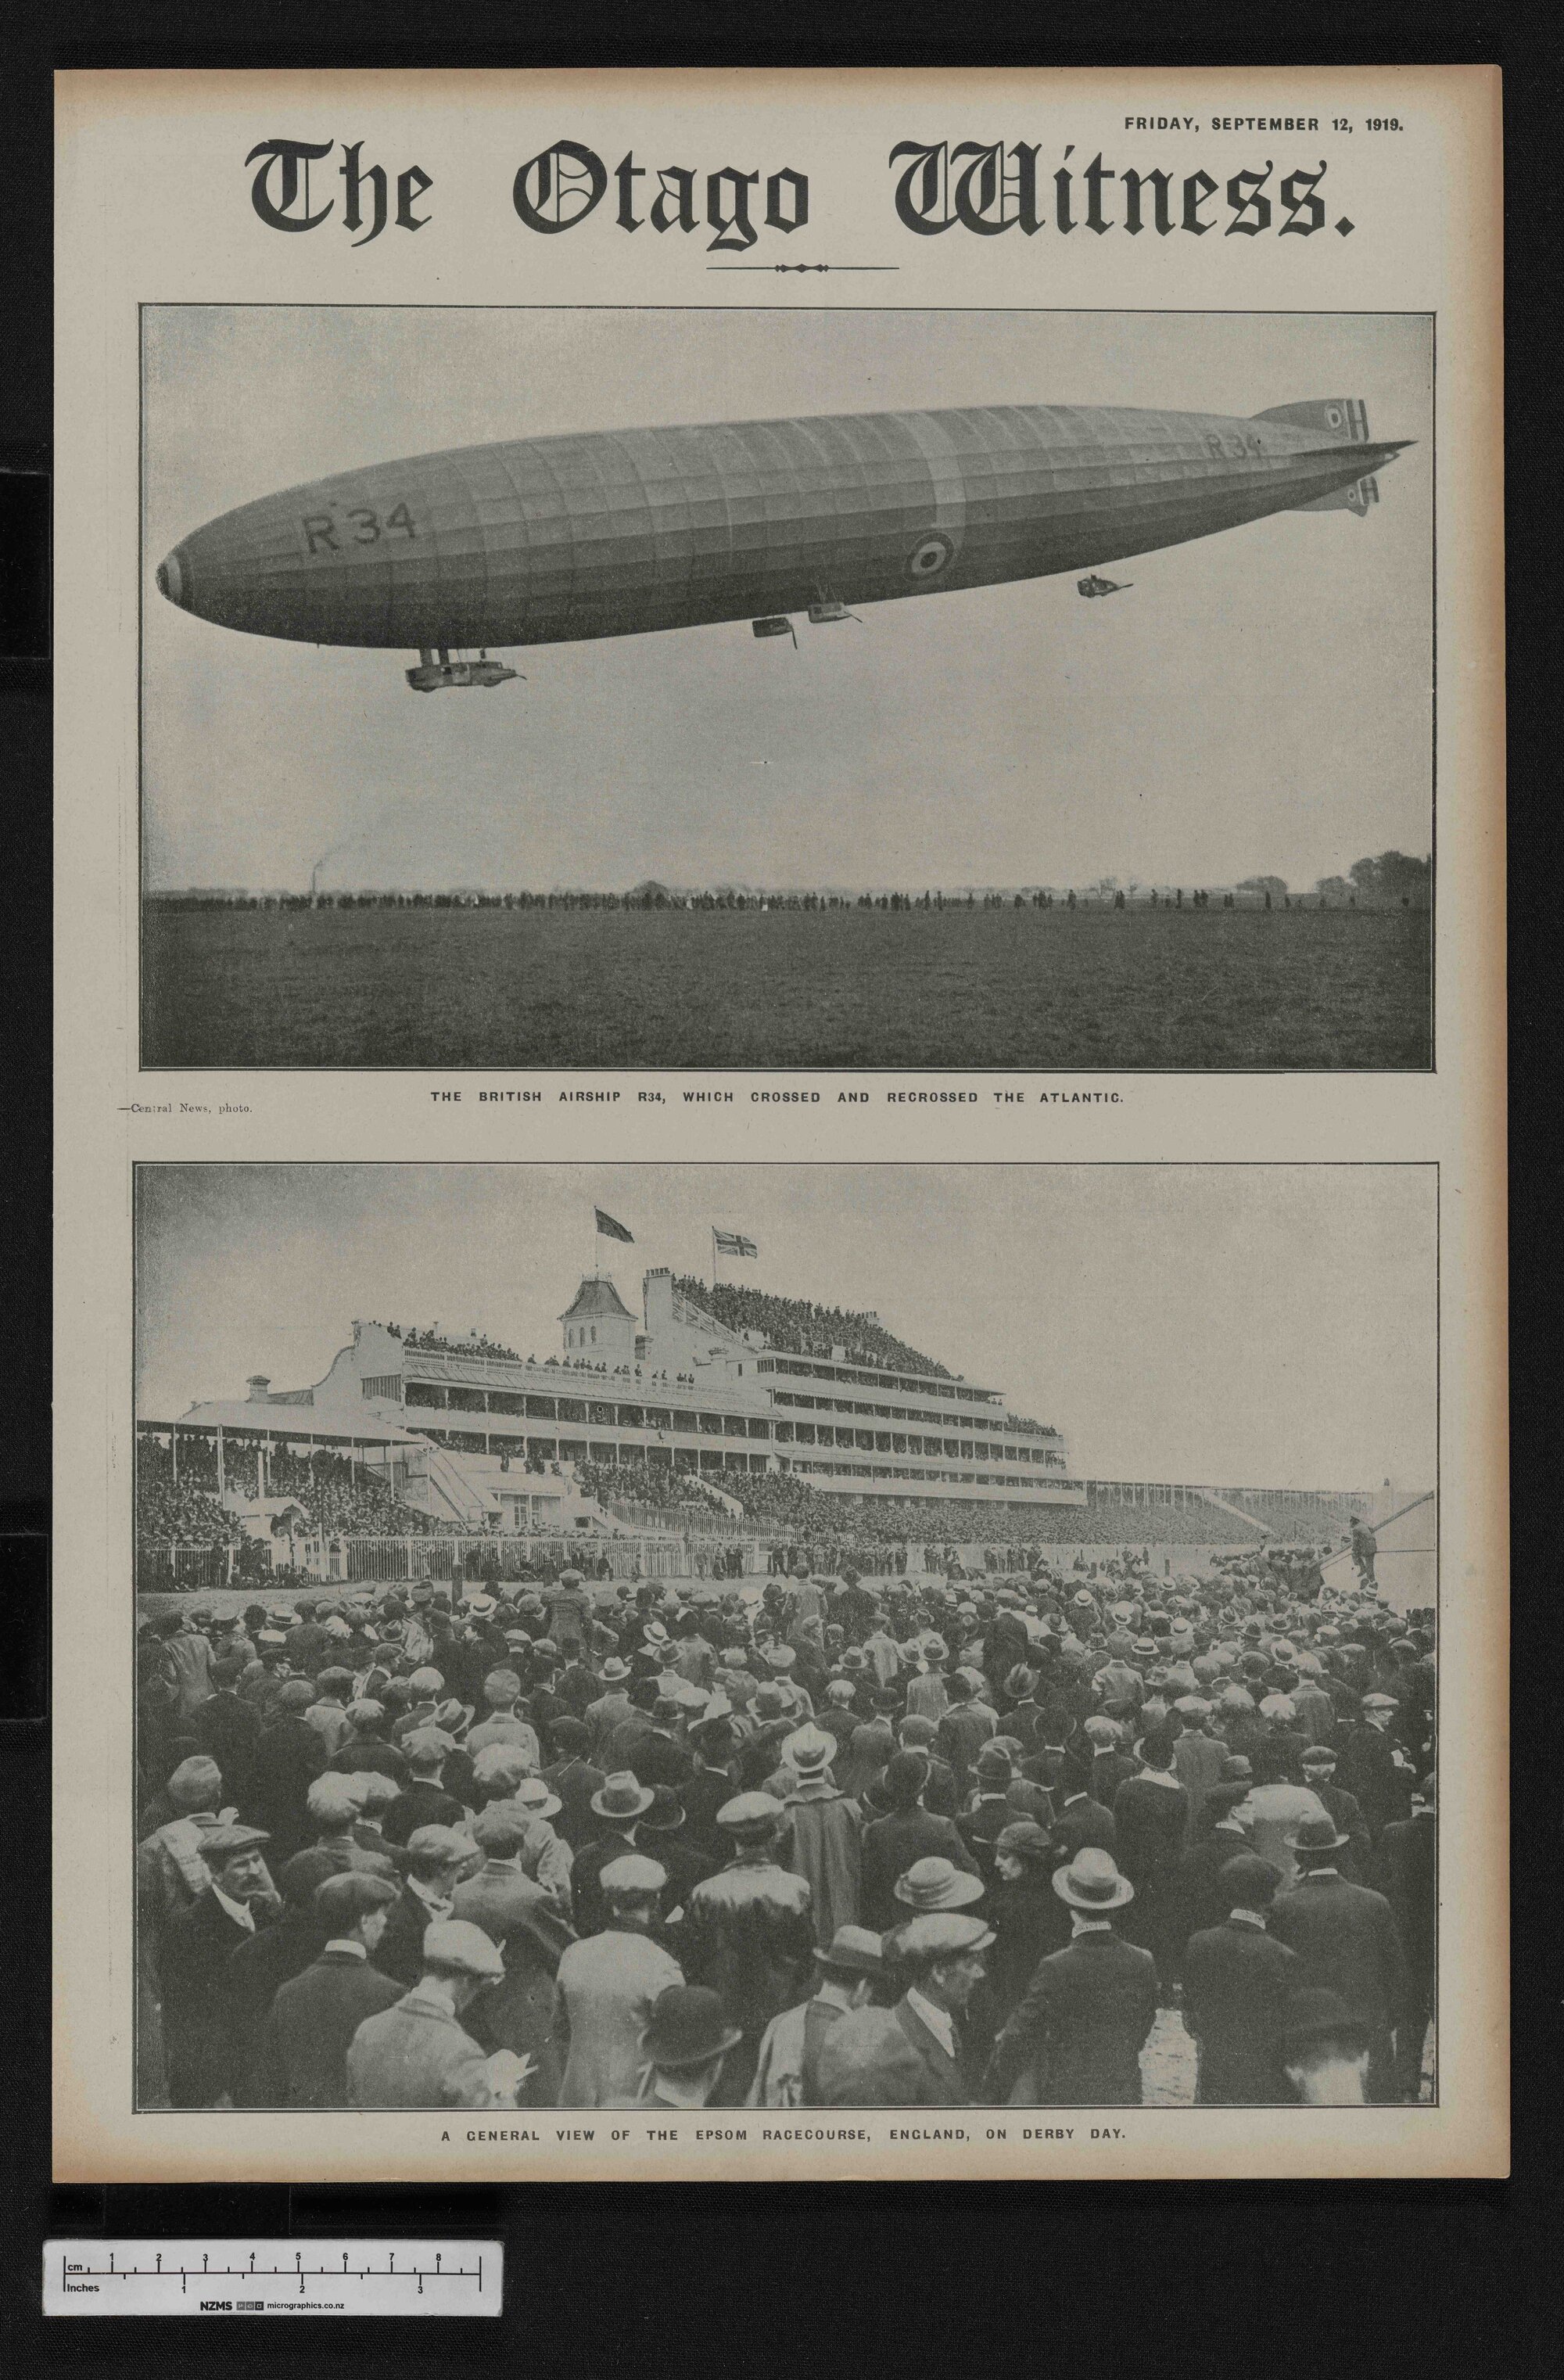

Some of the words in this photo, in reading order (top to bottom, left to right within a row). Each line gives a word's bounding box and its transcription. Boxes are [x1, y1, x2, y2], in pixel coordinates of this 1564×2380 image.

[1125, 117, 1200, 133] FRIDAY,
[1211, 117, 1319, 131] SEPTEMBER
[1332, 118, 1353, 134] 12,
[1365, 117, 1404, 131] 1919.
[244, 138, 434, 248] The
[512, 139, 809, 253] Otago
[888, 140, 1355, 238] Witness.
[431, 1092, 461, 1102] THE
[479, 1092, 541, 1102] BRITISH
[559, 1092, 621, 1102] AIRSHIP
[638, 1092, 665, 1104] R34,
[683, 1092, 734, 1102] WHICH
[751, 1092, 820, 1103] CROSSED
[838, 1092, 870, 1103] AND
[887, 1092, 978, 1103] RECROSSED
[993, 1092, 1024, 1103] THE
[1040, 1092, 1124, 1103] ATLANTIC.
[179, 1103, 211, 1115] News,
[218, 1103, 253, 1115] photo.
[441, 2131, 450, 2141] A
[466, 2130, 540, 2141] GENERAL
[556, 2130, 595, 2141] VIEW
[611, 2130, 630, 2141] OF
[646, 2130, 678, 2141] THE
[696, 2130, 747, 2141] EPSOM
[762, 2129, 870, 2142] RACECOURSE,
[890, 2129, 970, 2142] ENGLAND,
[986, 2129, 1006, 2140] ON
[1023, 2128, 1074, 2139] DERBY
[1090, 2128, 1128, 2139] DAY.
[109, 2253, 114, 2261] 1
[156, 2253, 162, 2262] 2
[203, 2253, 209, 2262] 3
[249, 2252, 256, 2261] 4
[295, 2252, 302, 2261] 5
[342, 2252, 349, 2261] 6
[389, 2252, 394, 2261] 7
[435, 2253, 442, 2261] 8
[66, 2283, 100, 2292] Inches
[181, 2285, 186, 2294] 1
[299, 2285, 306, 2294] 2
[418, 2285, 424, 2295] 3
[199, 2301, 233, 2311] NZMS
[267, 2301, 345, 2311] micrographics.co.nz
